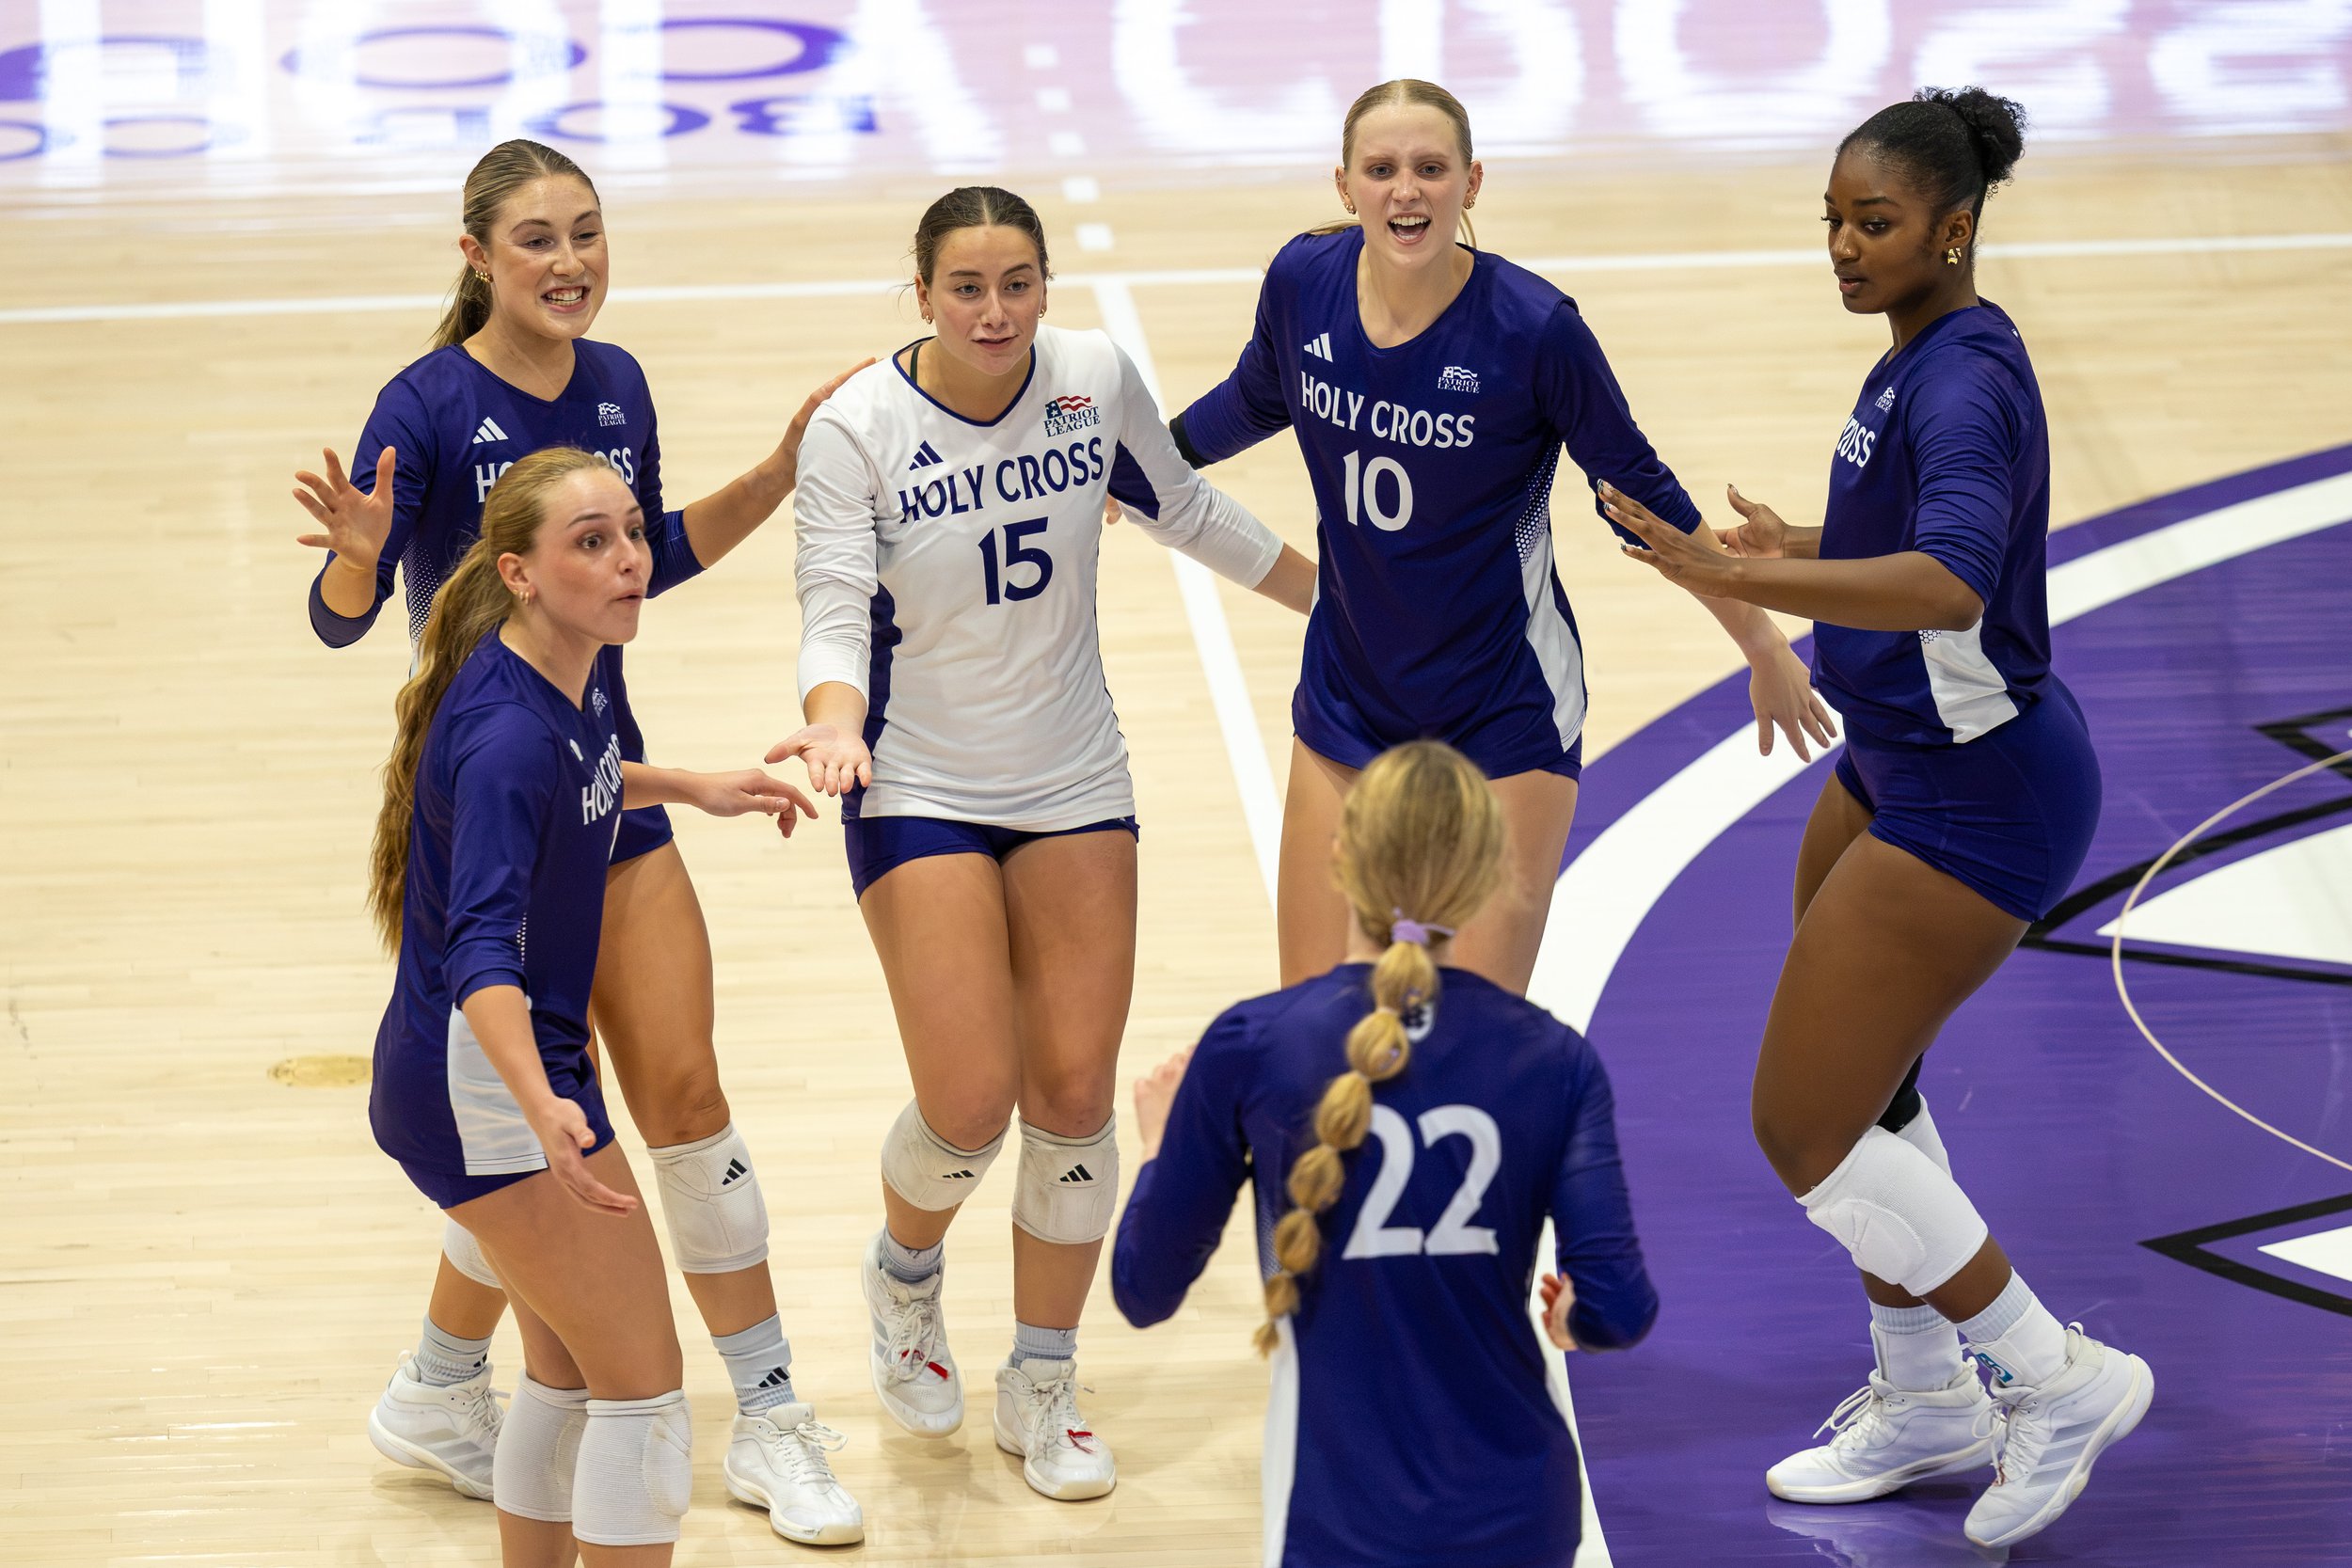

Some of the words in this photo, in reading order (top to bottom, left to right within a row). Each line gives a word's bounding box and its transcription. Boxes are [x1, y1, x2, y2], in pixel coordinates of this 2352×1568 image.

[1301, 371, 1364, 431] HOLY
[1371, 401, 1475, 448] CROSS
[1438, 376, 1481, 387] PATRIOT
[1438, 383, 1480, 393] LEAGUE
[1043, 405, 1099, 429] PATRIOT
[1046, 414, 1101, 437] LEAGUE
[1836, 414, 1875, 467] ROSS
[898, 465, 984, 524] HOLY
[996, 436, 1104, 502] CROSS
[1343, 450, 1413, 531] 10
[977, 516, 1054, 606] 15
[1342, 1103, 1502, 1259] 22
